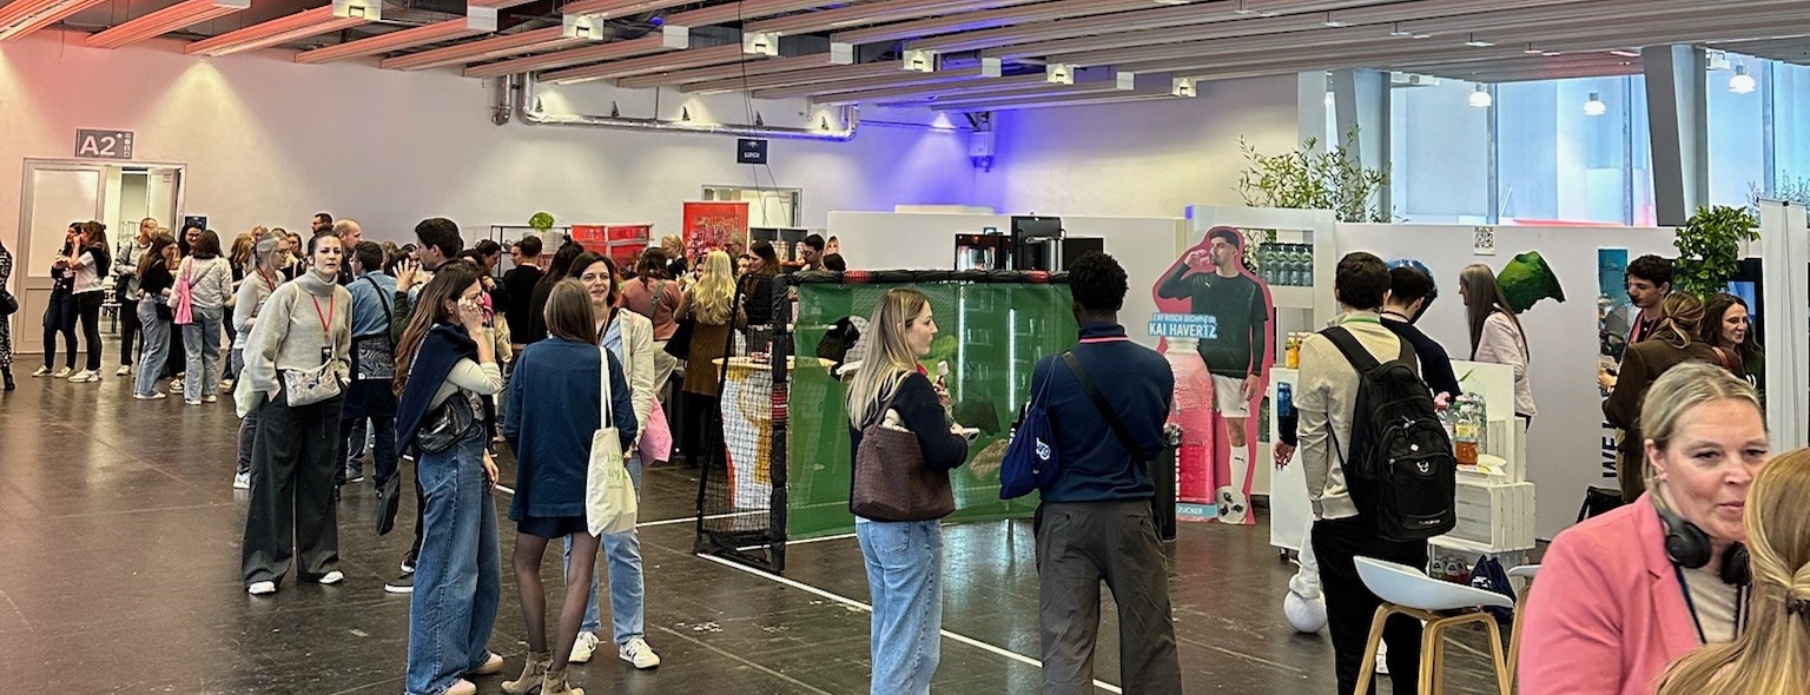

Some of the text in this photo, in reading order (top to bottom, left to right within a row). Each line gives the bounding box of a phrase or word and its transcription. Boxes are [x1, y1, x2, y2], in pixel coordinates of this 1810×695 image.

[80, 135, 116, 156] A2
[1149, 322, 1218, 339] KAI HAVERTZ
[1602, 437, 1617, 478] WE
